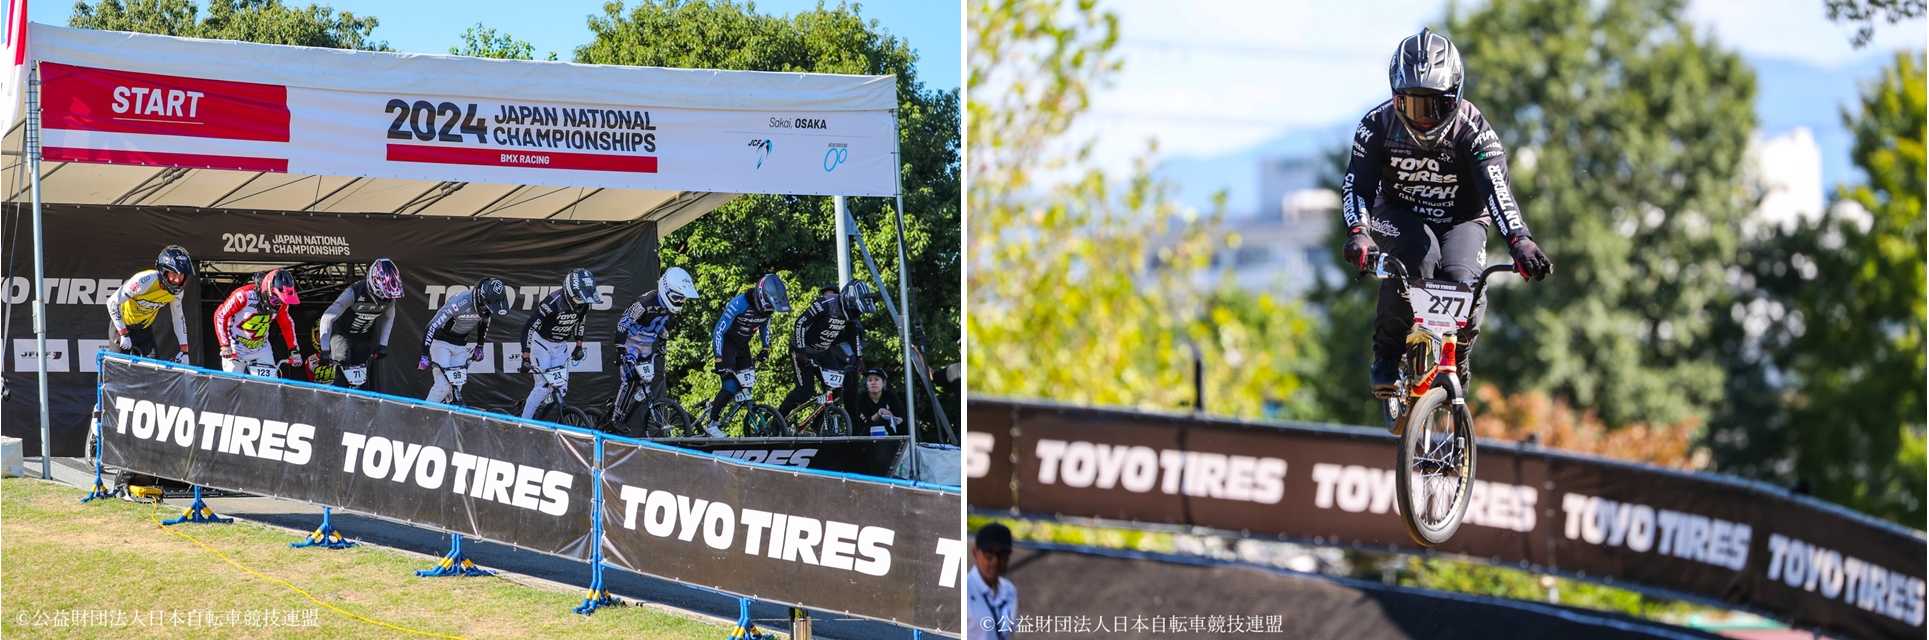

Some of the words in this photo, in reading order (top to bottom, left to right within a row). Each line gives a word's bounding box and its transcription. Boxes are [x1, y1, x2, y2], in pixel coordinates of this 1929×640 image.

[111, 86, 205, 118] START
[385, 98, 488, 144] 2024
[494, 104, 558, 126] JAPAN
[562, 107, 657, 131] NATIONAL
[795, 118, 827, 130] OSAKA
[493, 126, 657, 153] CHAMPIONSHIPS
[500, 153, 518, 163] BMX
[519, 154, 550, 165] RACING
[1390, 157, 1440, 172] TOYO
[1397, 170, 1457, 184] TIRES
[222, 232, 272, 253] 2024
[272, 234, 302, 245] JAPAN
[303, 235, 350, 246] NATIONAL
[272, 244, 351, 256] CHAMPIONSHIPS
[43, 278, 125, 305] TIRE
[1427, 295, 1465, 318] 277
[257, 368, 271, 377] 123
[115, 396, 196, 448] TOYO
[199, 411, 316, 466] TIRES
[341, 431, 447, 490] TOYO
[452, 451, 574, 517] TIRES
[1035, 438, 1159, 493] TOYO
[1160, 449, 1288, 504] TIRES
[1312, 462, 1420, 520] TOY
[620, 484, 736, 551] TOYO
[740, 507, 895, 577] TIRES
[1562, 492, 1656, 553] TOYO
[1656, 509, 1752, 571] TIRES
[1768, 532, 1844, 599] TOYO
[1844, 555, 1926, 627] TIRES
